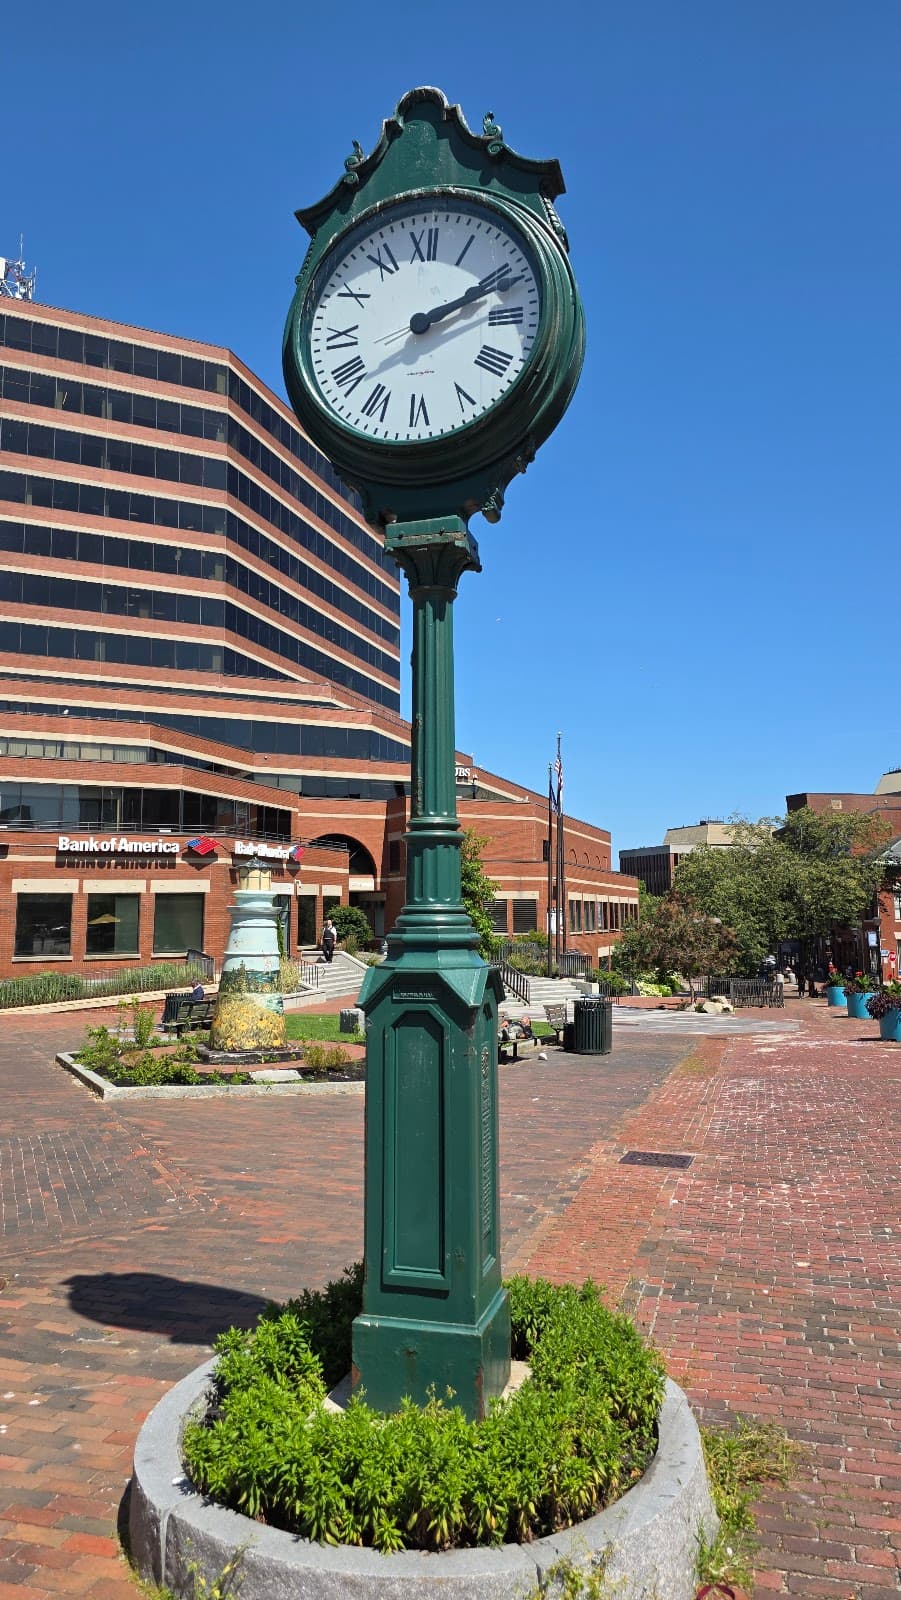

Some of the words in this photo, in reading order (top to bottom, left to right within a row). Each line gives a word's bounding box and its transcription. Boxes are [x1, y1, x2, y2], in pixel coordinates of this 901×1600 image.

[366, 242, 400, 282] XI
[409, 228, 439, 265] XII
[454, 234, 476, 266] I
[478, 262, 513, 286] II
[337, 282, 371, 309] X
[488, 306, 524, 327] III
[326, 324, 359, 351] IX
[330, 355, 369, 398] VIII
[473, 344, 514, 378] IIII
[360, 383, 392, 423] VII
[408, 393, 430, 428] VI
[452, 381, 477, 413] V
[58, 836, 99, 852] Bank
[100, 837, 117, 852] of
[117, 838, 180, 853] America
